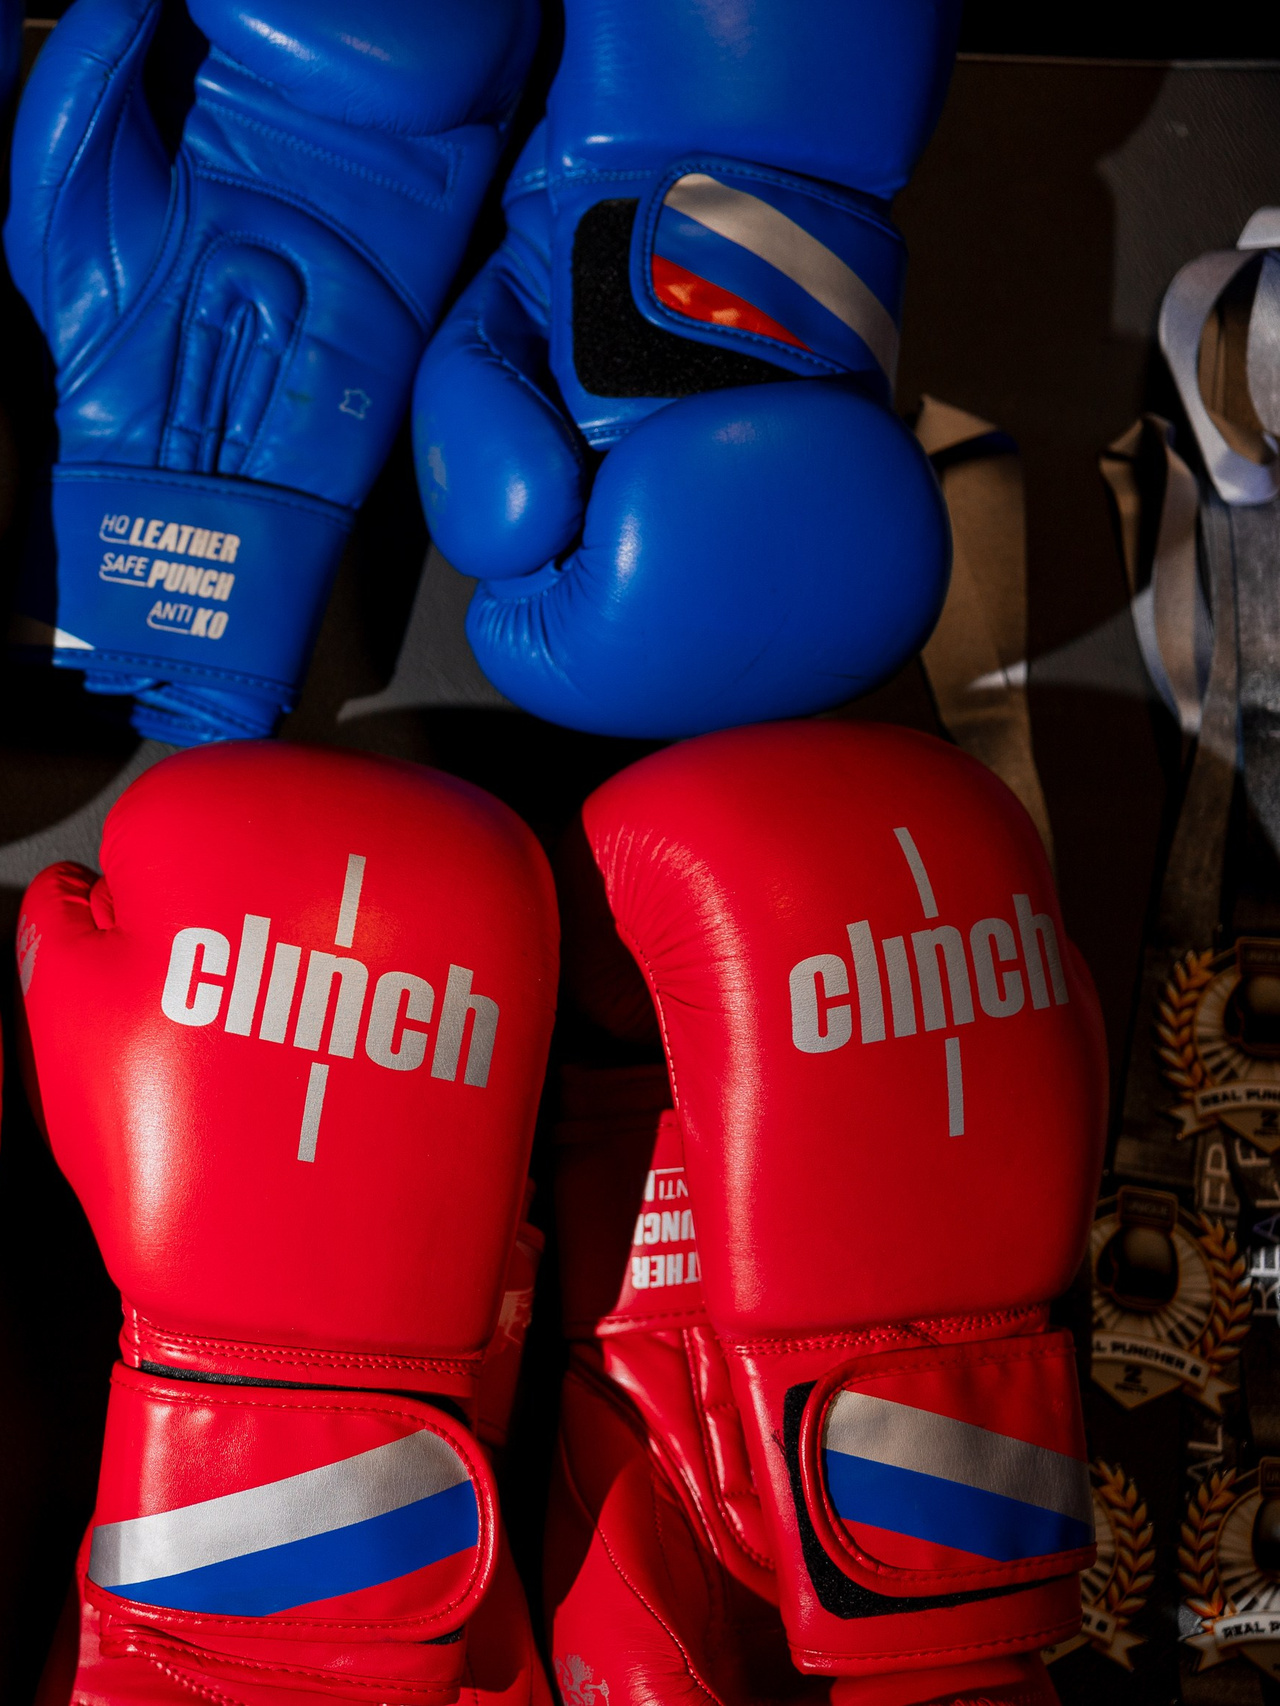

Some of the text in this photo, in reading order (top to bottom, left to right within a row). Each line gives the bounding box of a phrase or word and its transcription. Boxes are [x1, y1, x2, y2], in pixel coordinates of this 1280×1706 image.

[102, 513, 241, 564] HQ LEATHER
[100, 552, 236, 602] SAFE PUNCH
[150, 600, 230, 641] ANTI KO
[788, 893, 1071, 1054] clinch
[161, 913, 501, 1089] clinch
[658, 1178, 689, 1201] NTI
[633, 1209, 696, 1247] UNC
[631, 1251, 702, 1290] THER
[1124, 1364, 1142, 1383] 2
